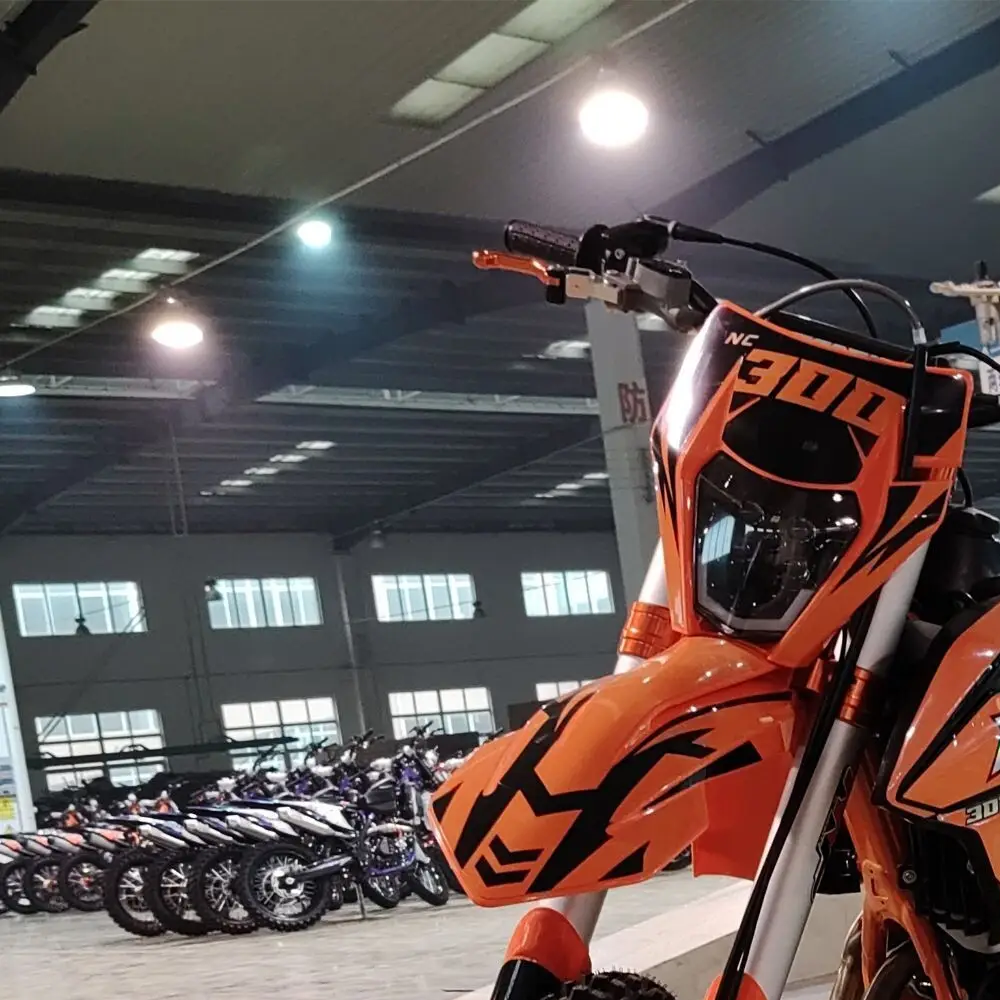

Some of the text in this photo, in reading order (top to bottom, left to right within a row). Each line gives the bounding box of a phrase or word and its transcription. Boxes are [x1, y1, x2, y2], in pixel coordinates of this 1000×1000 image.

[724, 331, 760, 347] NC
[618, 382, 649, 423] 防
[733, 348, 908, 436] 300
